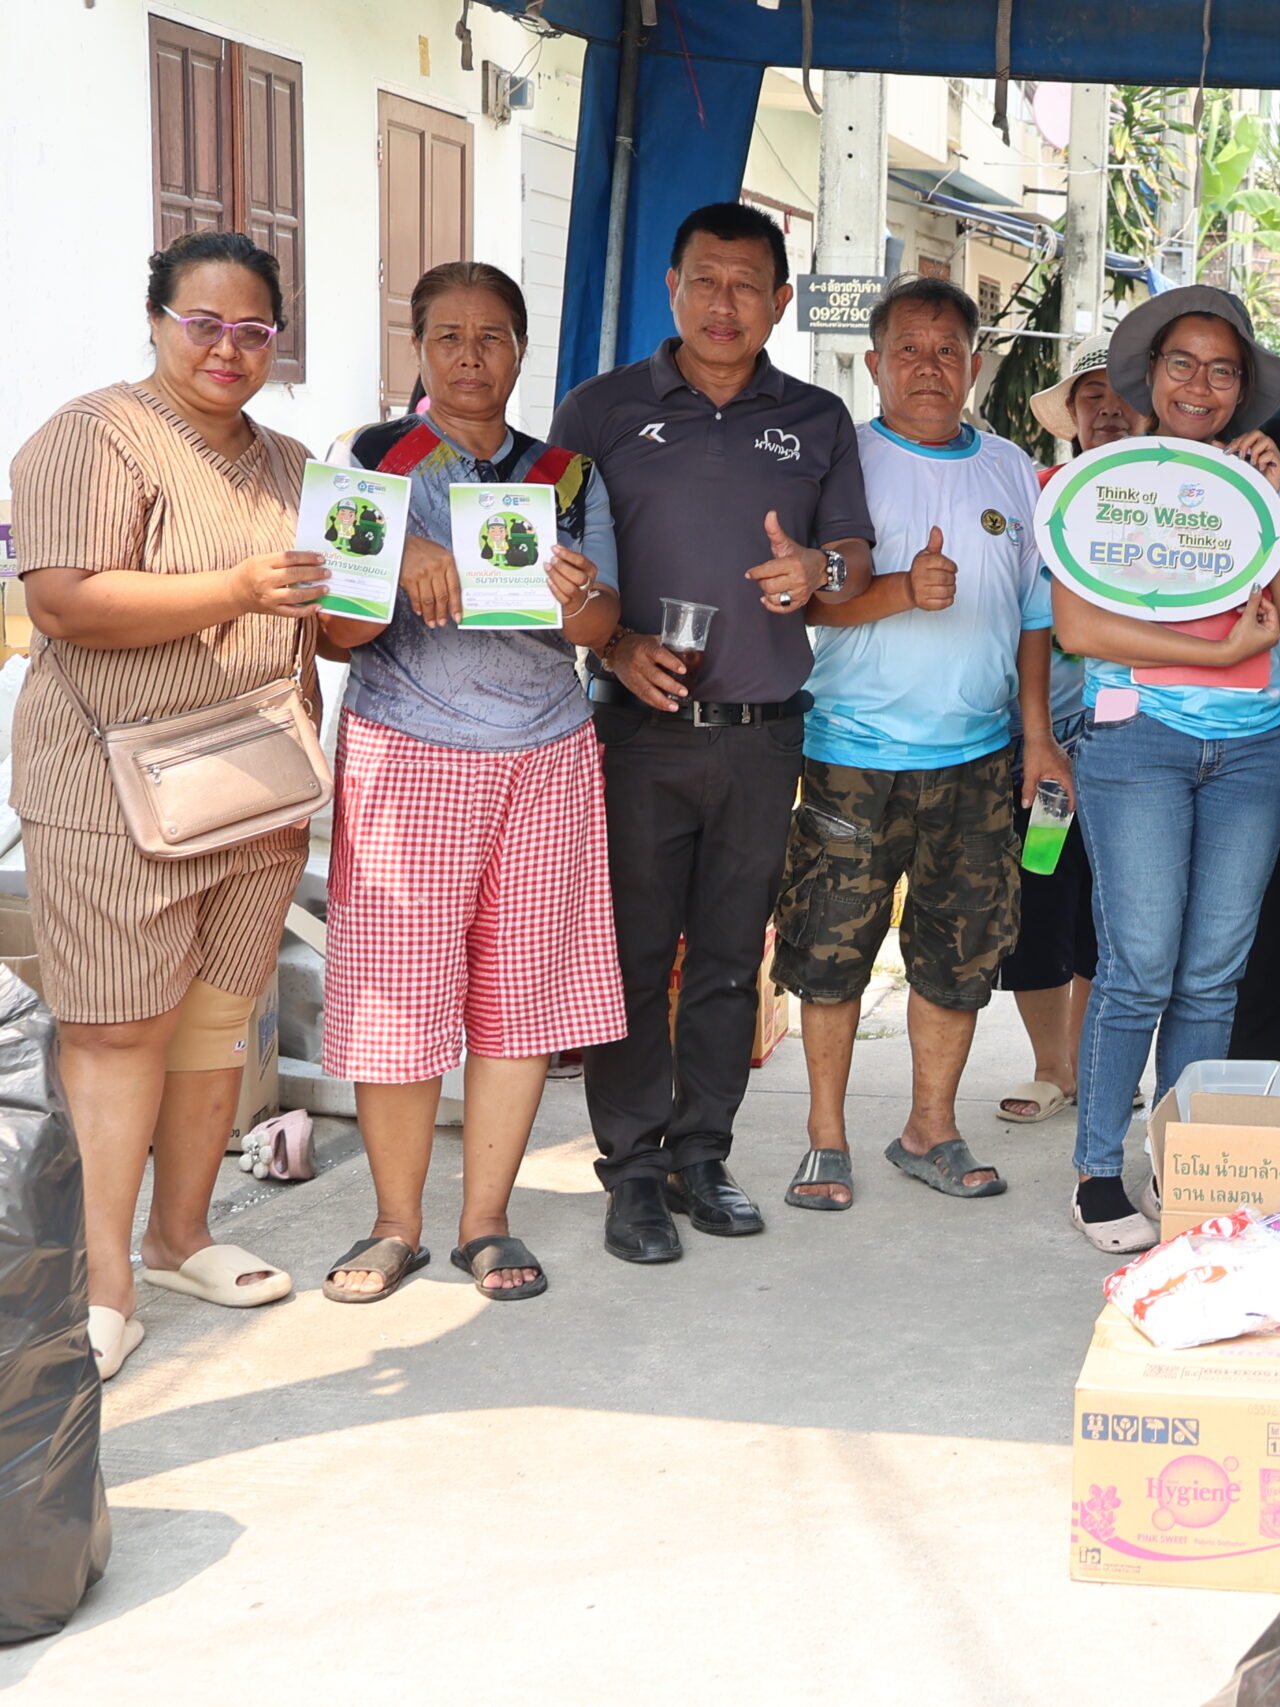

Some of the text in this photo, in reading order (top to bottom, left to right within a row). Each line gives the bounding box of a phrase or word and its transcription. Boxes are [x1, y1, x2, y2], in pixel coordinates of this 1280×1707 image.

[829, 293, 860, 307] 087
[1096, 485, 1158, 504] Think of
[1096, 503, 1222, 530] Zero Waste
[1178, 533, 1232, 550] Think of
[1090, 541, 1235, 577] EEP Group
[1173, 1153, 1210, 1176] โอโม
[1172, 1187, 1264, 1205] จาน เลมอน
[1145, 1476, 1242, 1507] Hygiene
[1137, 1532, 1188, 1545] PINK SWEET
